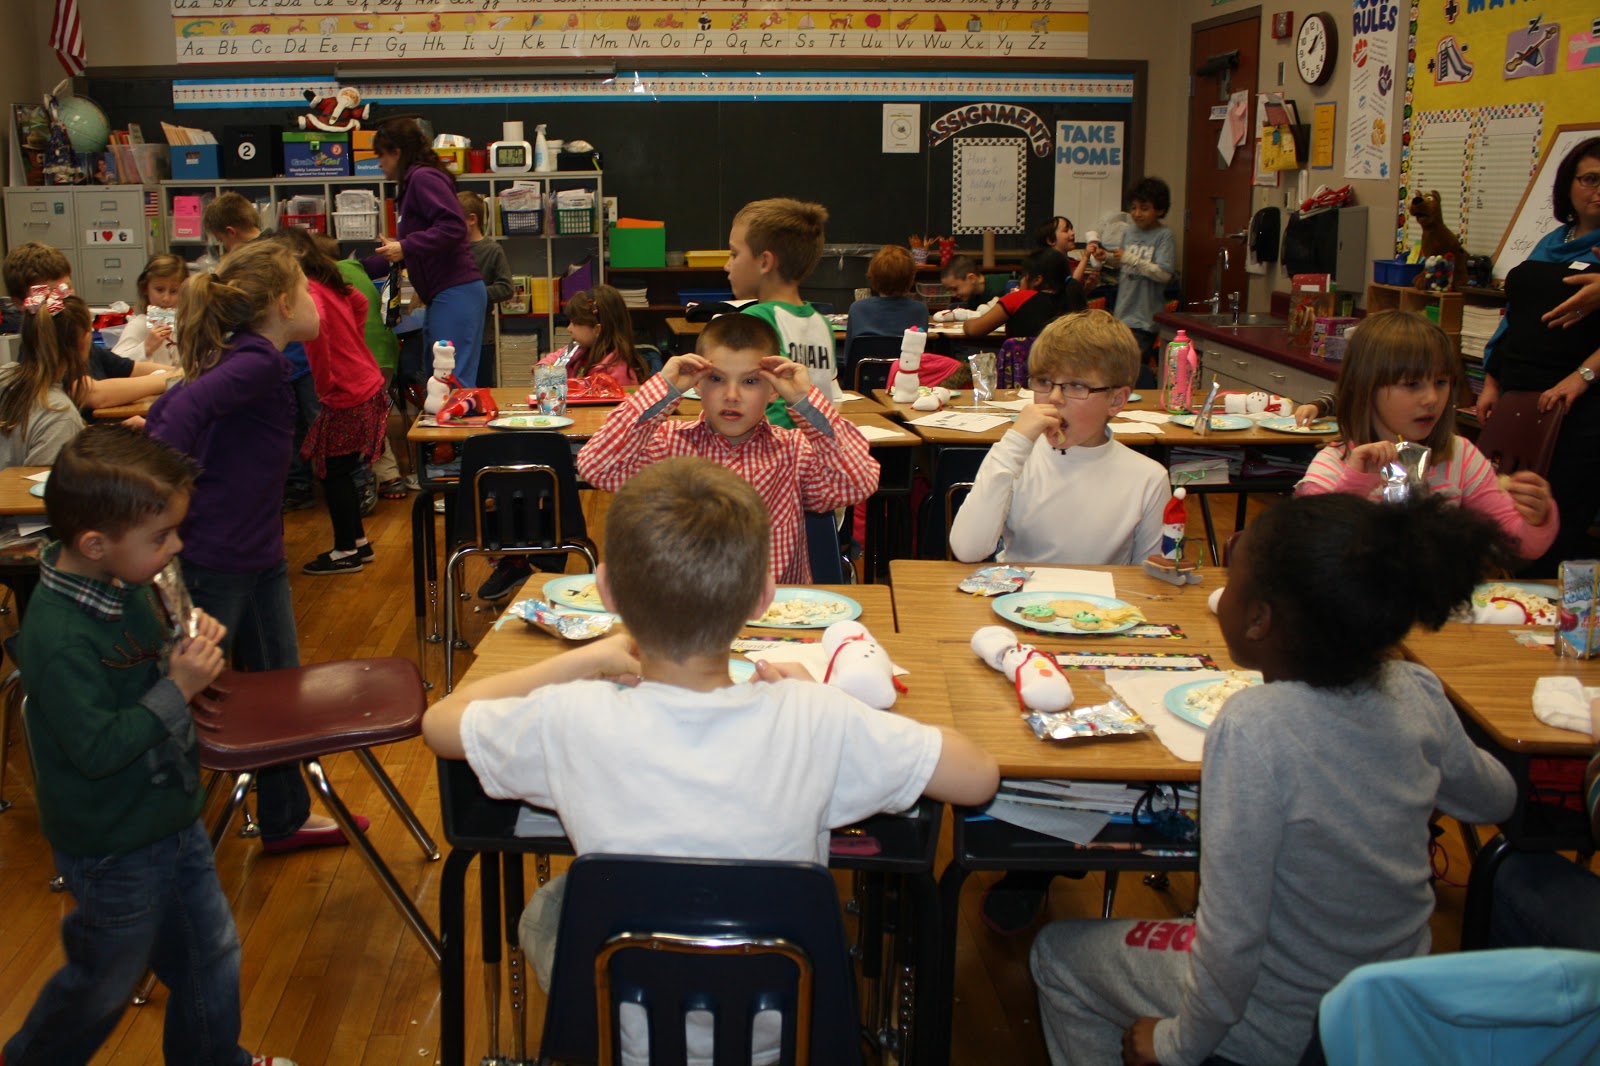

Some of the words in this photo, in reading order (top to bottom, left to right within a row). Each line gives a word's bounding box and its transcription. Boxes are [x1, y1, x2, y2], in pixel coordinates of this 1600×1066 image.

[1353, 5, 1398, 37] RULES
[183, 41, 204, 56] Aa
[218, 40, 238, 55] Bb
[251, 39, 272, 54] Cc
[284, 38, 307, 53] Dd
[319, 38, 339, 53] Ee
[351, 37, 372, 52] Ff
[385, 36, 407, 57] Gg
[423, 36, 445, 51] Hh
[462, 35, 475, 50] Ii
[488, 35, 505, 56] Jj
[521, 34, 546, 49] Kk
[561, 34, 577, 49] Ll
[590, 33, 618, 48] Mm
[628, 33, 650, 48] Nn
[660, 33, 681, 48] Oo
[693, 33, 713, 54] Pp
[726, 33, 748, 54] Qq
[760, 33, 782, 48] Rr
[795, 33, 815, 48] Ss
[829, 33, 846, 48] Tt
[861, 33, 883, 48] Uu
[895, 33, 914, 48] Vv
[923, 34, 952, 49] Ww
[961, 34, 984, 49] Xx
[997, 35, 1013, 55] Yy
[1027, 34, 1047, 50] Zz
[926, 104, 1053, 157] ASSIGNMENTS
[1061, 124, 1116, 143] TAKE
[243, 145, 251, 157] 2
[1057, 145, 1121, 166] HOME
[1510, 235, 1534, 256] stop
[1069, 656, 1115, 667] Sydney
